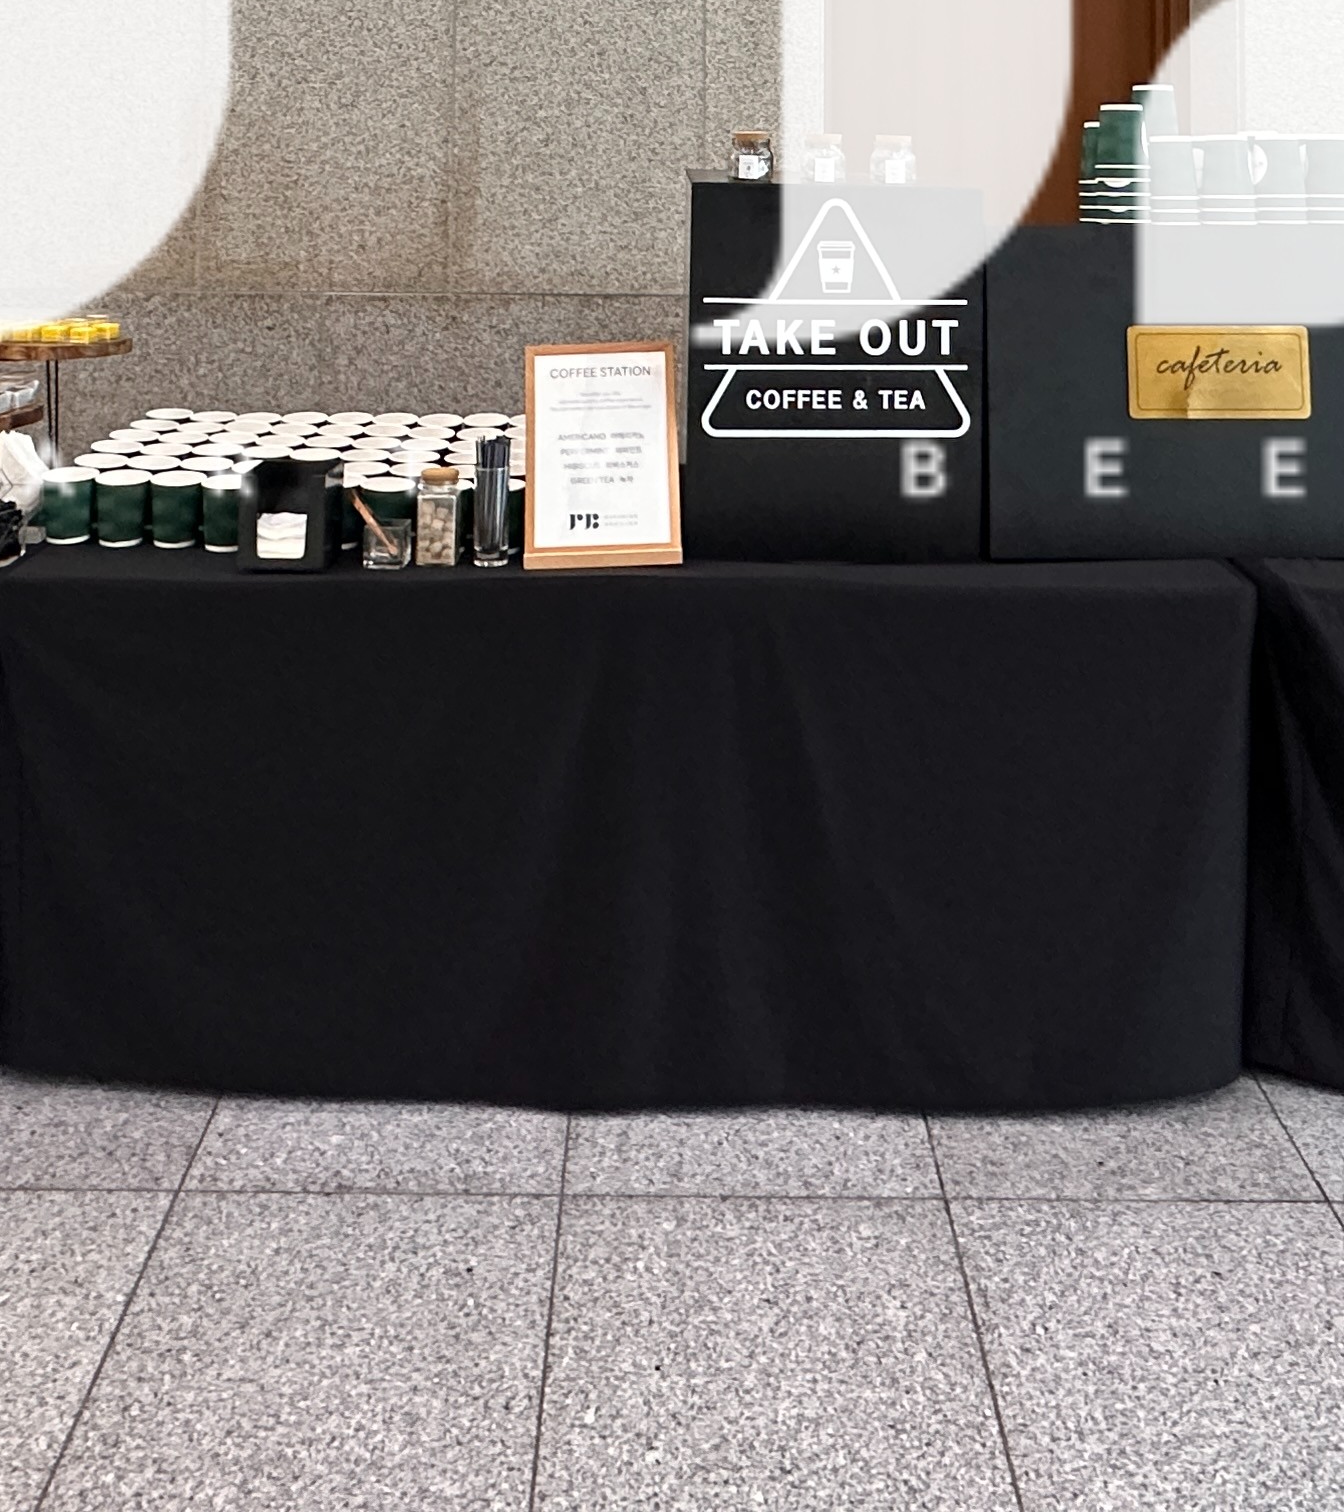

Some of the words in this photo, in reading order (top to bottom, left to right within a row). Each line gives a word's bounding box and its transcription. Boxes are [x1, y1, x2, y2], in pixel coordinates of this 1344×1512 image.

[713, 318, 837, 356] TAKE
[859, 318, 960, 356] OUT
[549, 367, 597, 379] COFFEE
[599, 365, 652, 378] STATION
[1156, 345, 1282, 390] cafeteria
[746, 389, 843, 411] COFFEE
[852, 390, 868, 410] &
[878, 390, 926, 410] TEA
